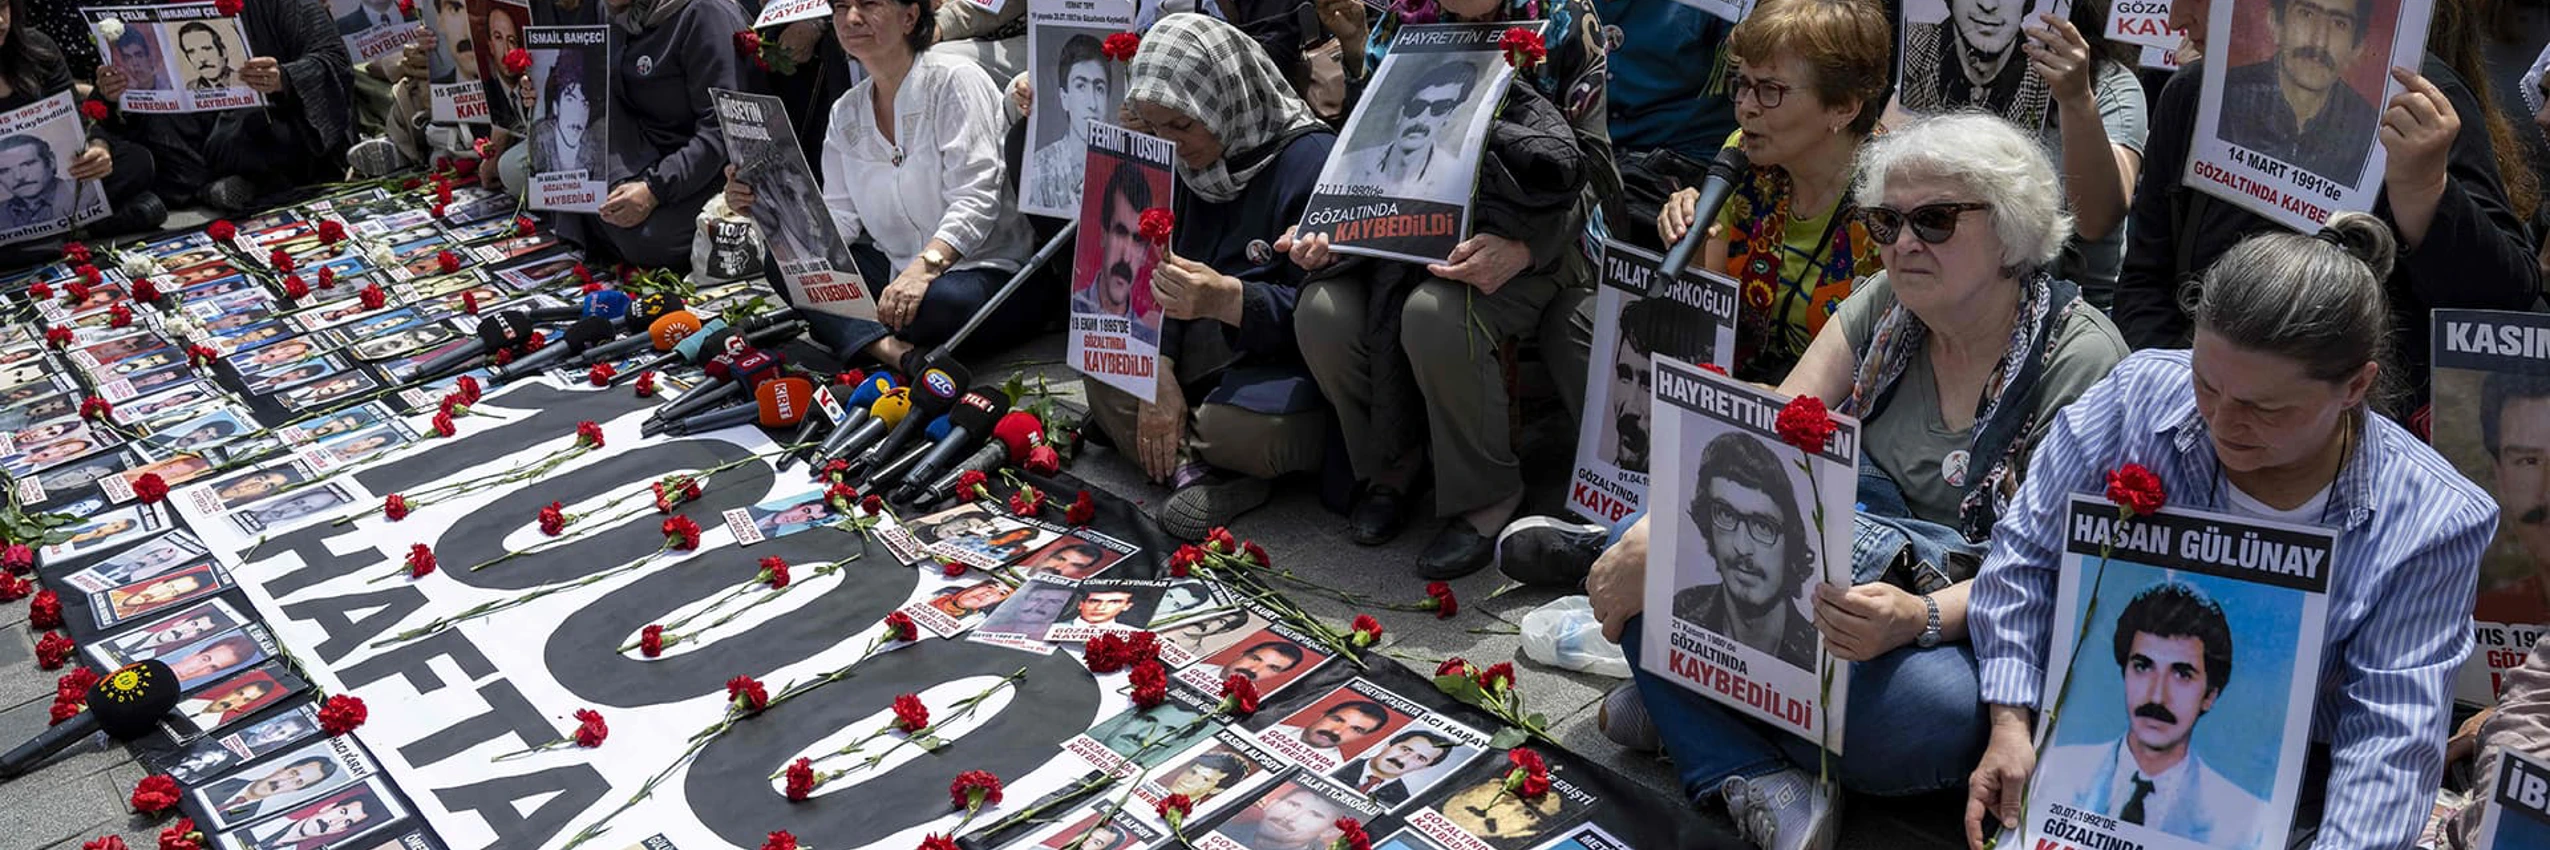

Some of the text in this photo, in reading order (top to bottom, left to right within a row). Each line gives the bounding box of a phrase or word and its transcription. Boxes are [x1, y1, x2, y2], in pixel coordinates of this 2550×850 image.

[202, 6, 222, 19] ÇEL
[2116, 0, 2169, 14] GÖZA
[360, 28, 418, 60] KAYBEDİL
[528, 29, 605, 45] İSMAİL BAHÇECİ
[1399, 29, 1482, 46] HAYRETTİN
[1089, 122, 1170, 166] FEHMİ TOSUN
[2228, 146, 2342, 202] 14 MART 1991'de
[2193, 160, 2331, 226] GÖZALTINDA KAYBE
[57, 203, 104, 230] ÇLİK
[1308, 202, 1399, 226] GÖZALTINDA
[1334, 213, 1454, 244] KAYBEDİLDİ
[803, 282, 864, 304] KAYBEDİLDİ
[1607, 256, 1732, 319] TALAT RKOĞLU
[1083, 349, 1154, 378] KAYBEDİLDİ
[926, 372, 953, 396] SZC
[1657, 370, 1778, 434] HAYRETTİN
[1578, 467, 1639, 507] GÖZALTINDA
[2073, 512, 2326, 581] HASAN GÜLÜNAY
[1670, 631, 1748, 676] GÖZALTINDA
[236, 515, 613, 850] HAFTA
[1668, 647, 1812, 731] KAYBEDİLDİ
[1216, 729, 1285, 773] KASIM ALPSOY
[1266, 729, 1337, 769] GÖZALTINDA
[1442, 722, 1489, 750] KARAY
[1257, 733, 1329, 774] KAYBEDİLDİ
[1296, 773, 1326, 794] TALAT
[2049, 802, 2118, 832] 20.07.1992'DE
